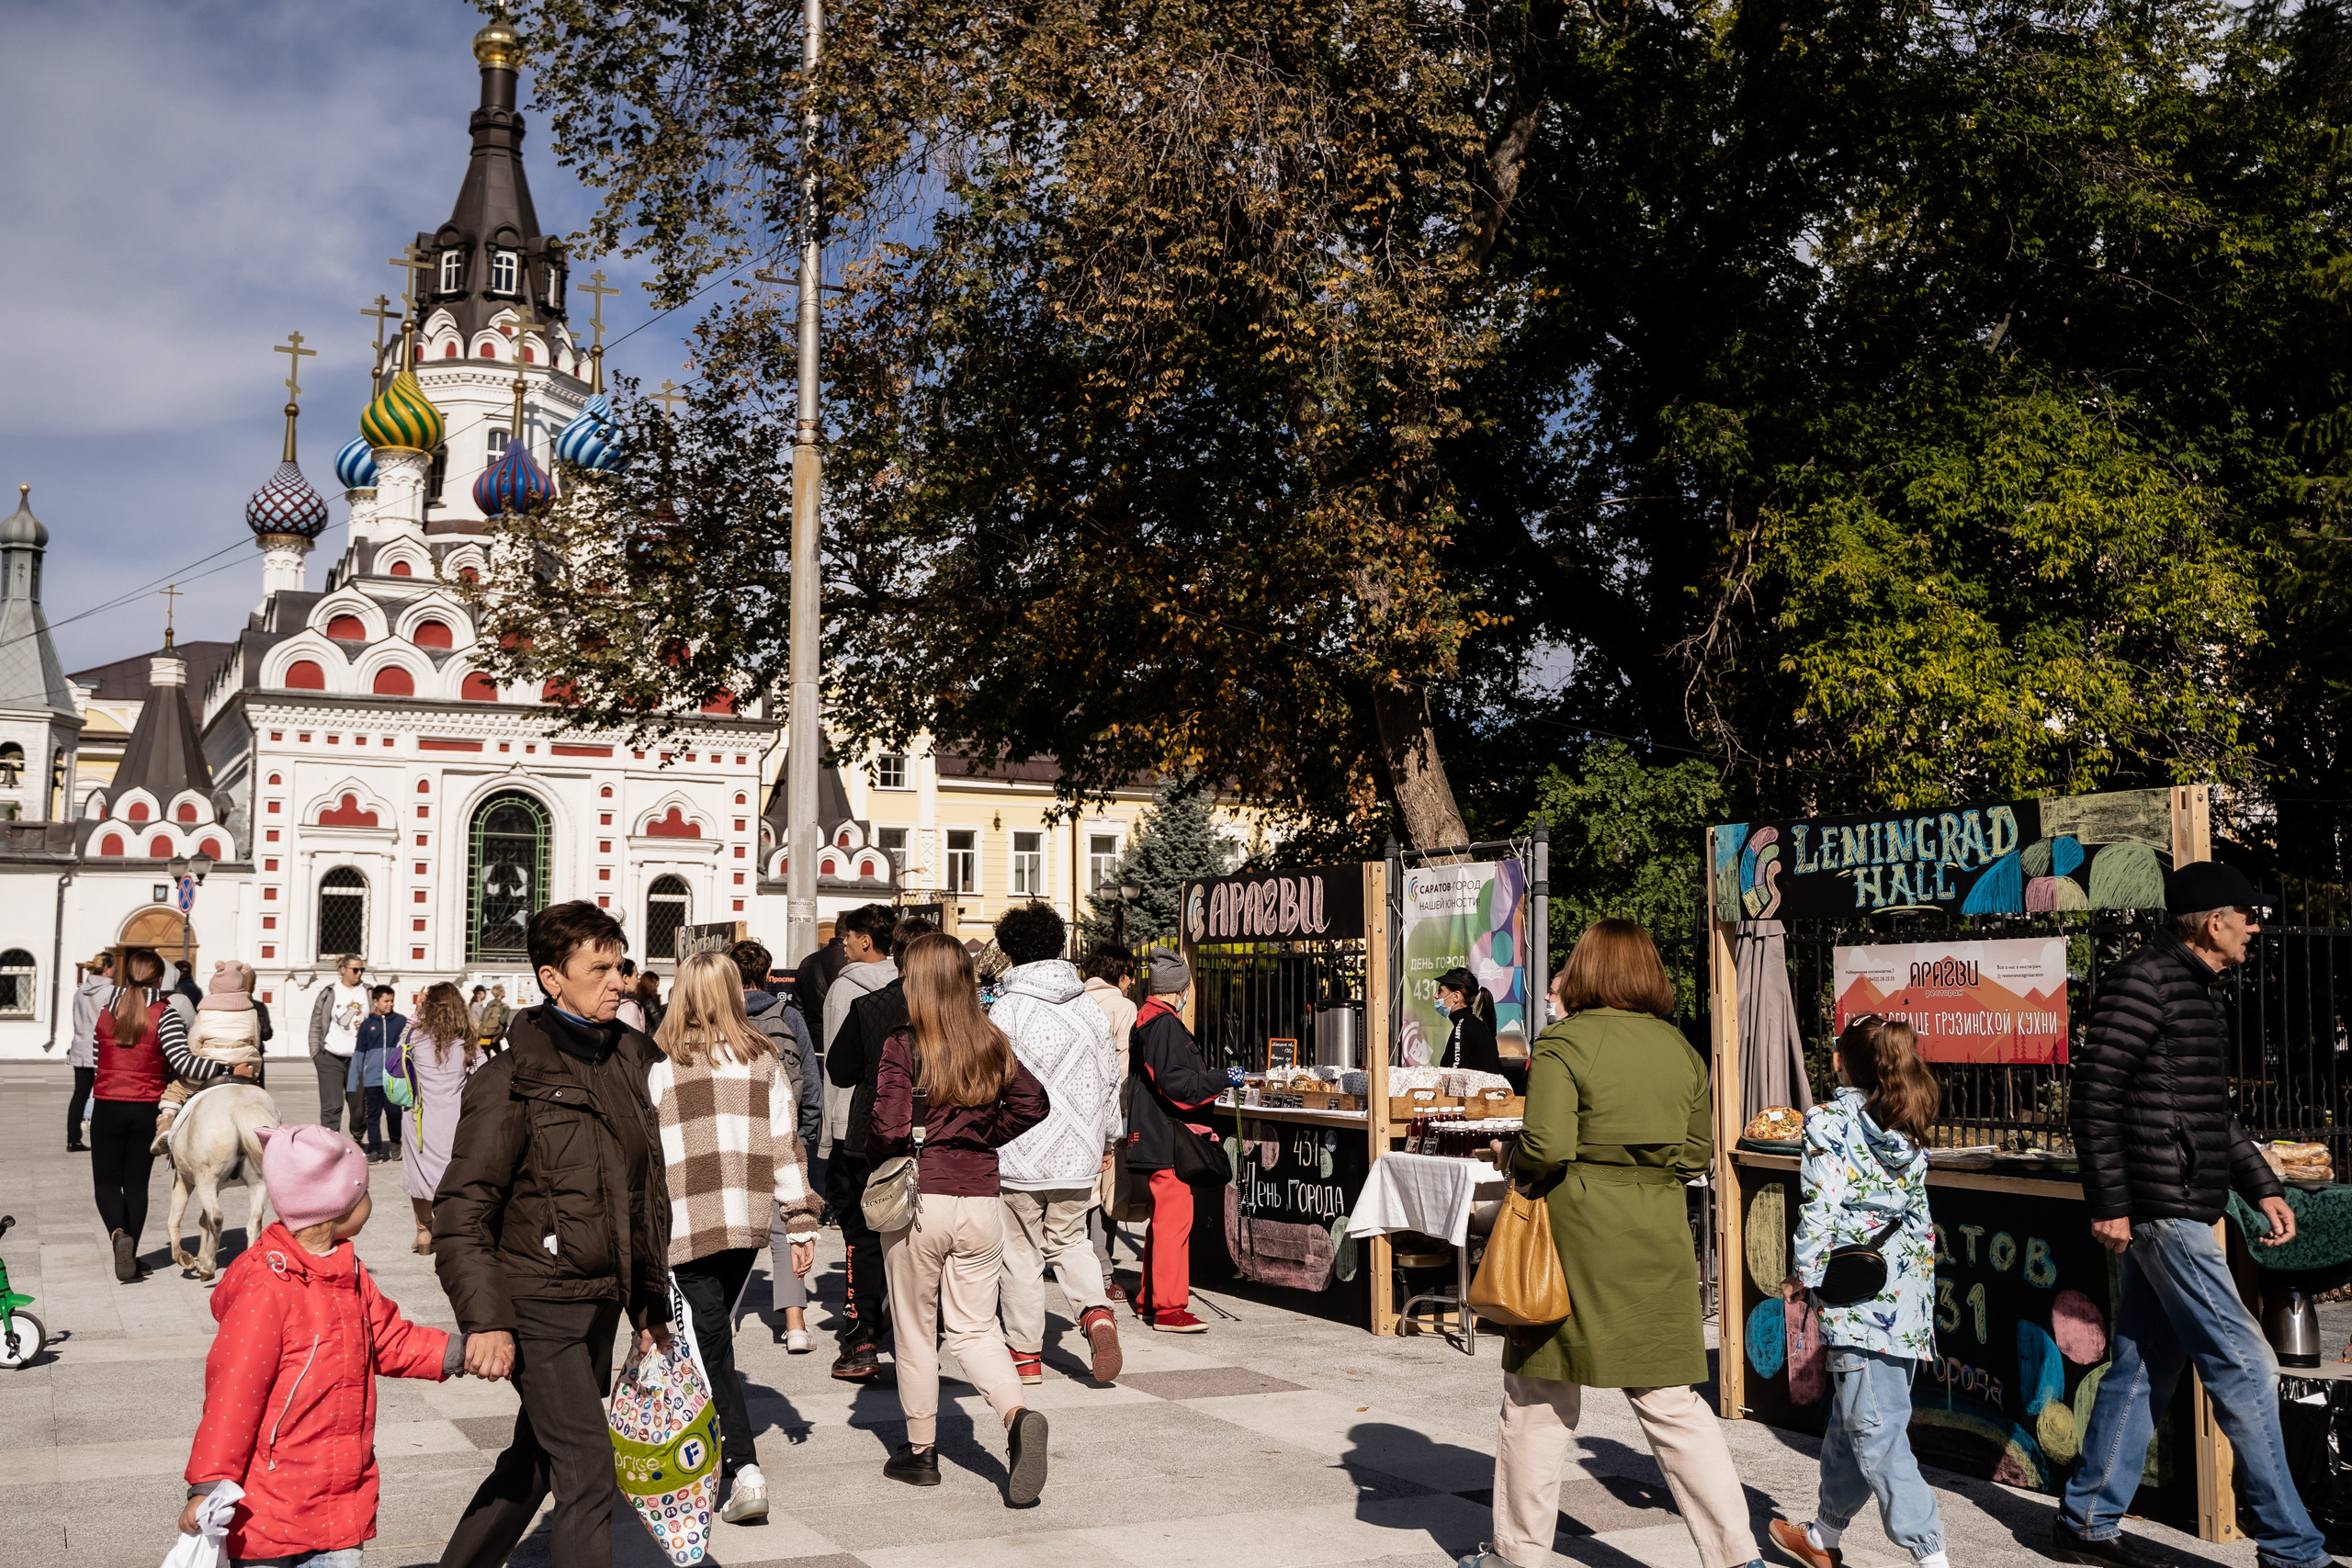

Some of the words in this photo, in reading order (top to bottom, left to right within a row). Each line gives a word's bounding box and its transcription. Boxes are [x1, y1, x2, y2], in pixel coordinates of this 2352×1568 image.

[1791, 806, 2018, 875] LENINGRAD
[1854, 862, 1956, 908] HALL
[1419, 898, 1445, 910] НАШЕЙ
[1445, 897, 1481, 908] ЮНОСТИ!
[1410, 958, 1433, 972] ДЕНЬ
[1436, 955, 1470, 968] ГОРОДА
[1413, 978, 1437, 1001] 431
[1926, 989, 1963, 998] ресторан
[1935, 1008, 2011, 1036] ГРУЗИНСКОЙ
[2017, 1010, 2058, 1035] КУХНИ
[1293, 1130, 1318, 1167] 431
[1240, 1161, 1282, 1213] День
[1935, 1277, 1988, 1345] 31
